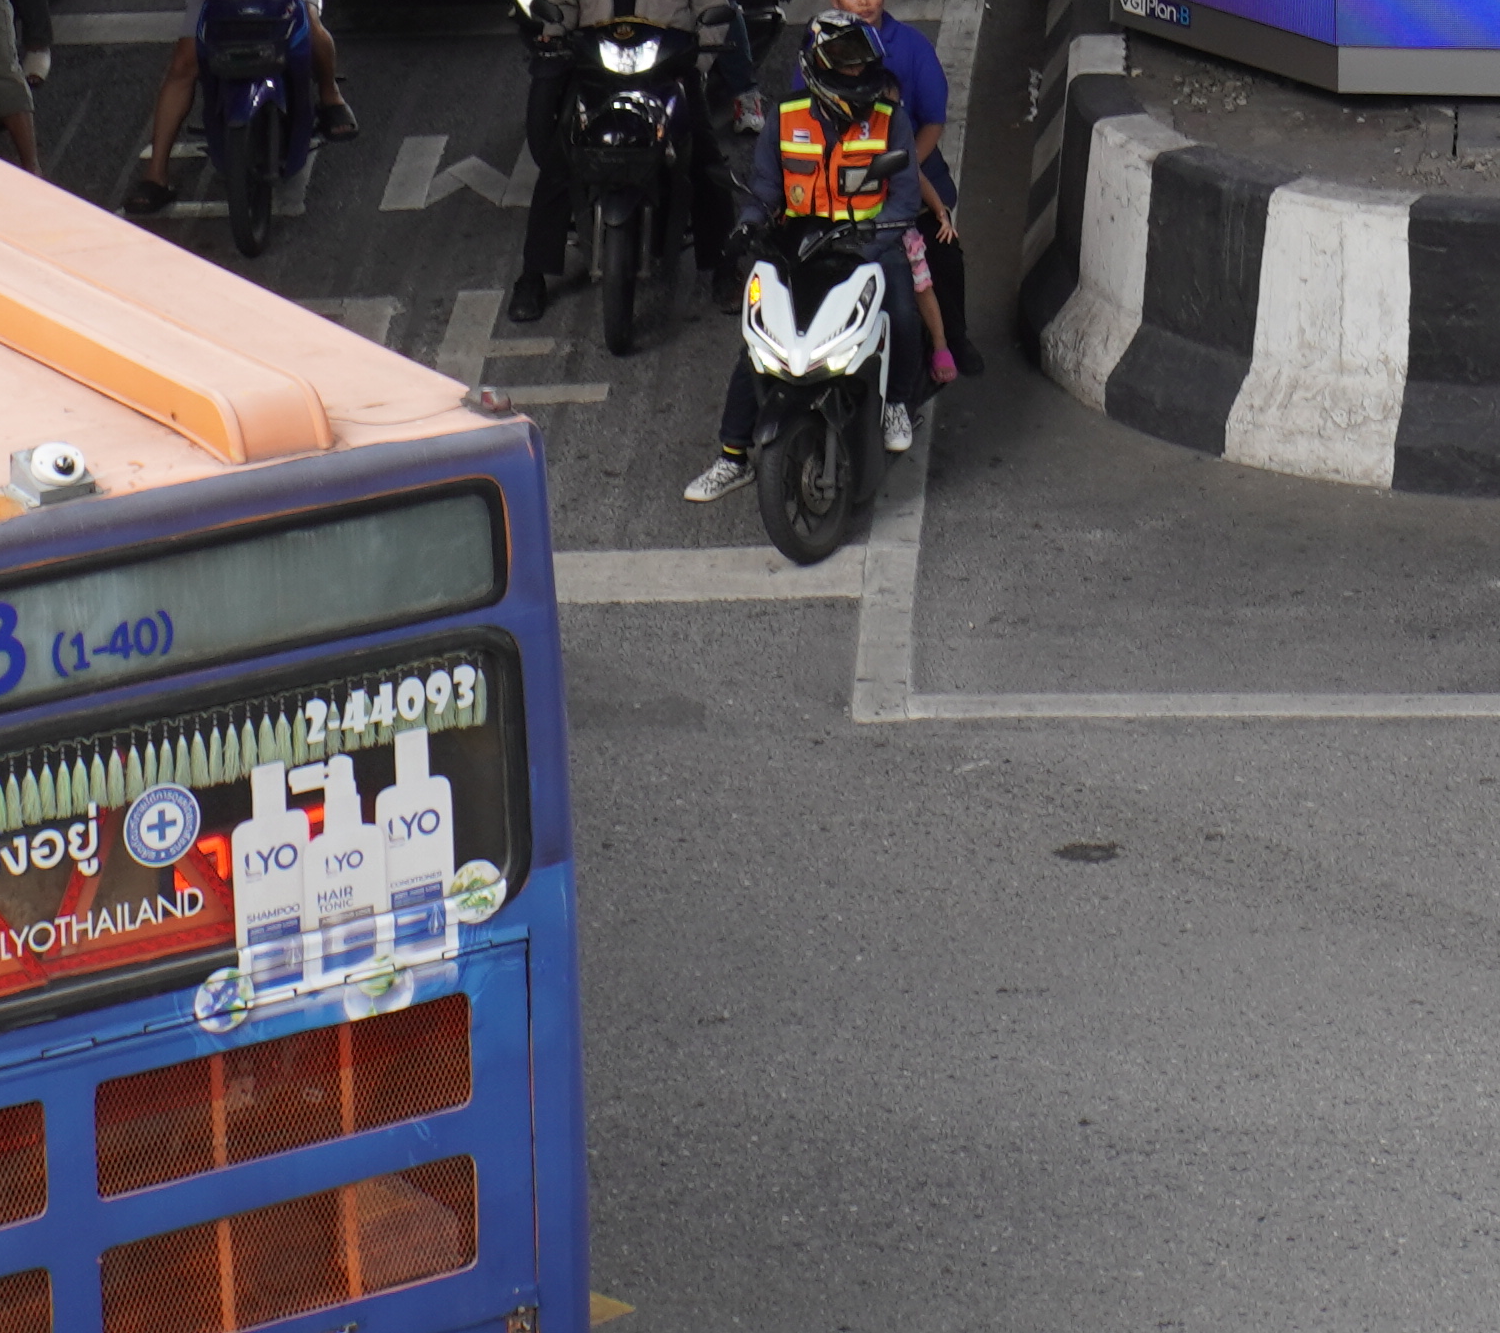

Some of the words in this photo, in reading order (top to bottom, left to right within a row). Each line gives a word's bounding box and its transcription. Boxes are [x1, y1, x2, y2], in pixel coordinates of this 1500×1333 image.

[857, 120, 868, 140] 3
[51, 610, 175, 678] (1-40)
[304, 665, 476, 744] 2-44093
[388, 808, 441, 844] LYO
[244, 843, 298, 878] LYO
[325, 849, 364, 876] LYO
[317, 886, 353, 905] HAIR
[319, 898, 354, 914] TONIC
[247, 903, 300, 925] SHAMPOO
